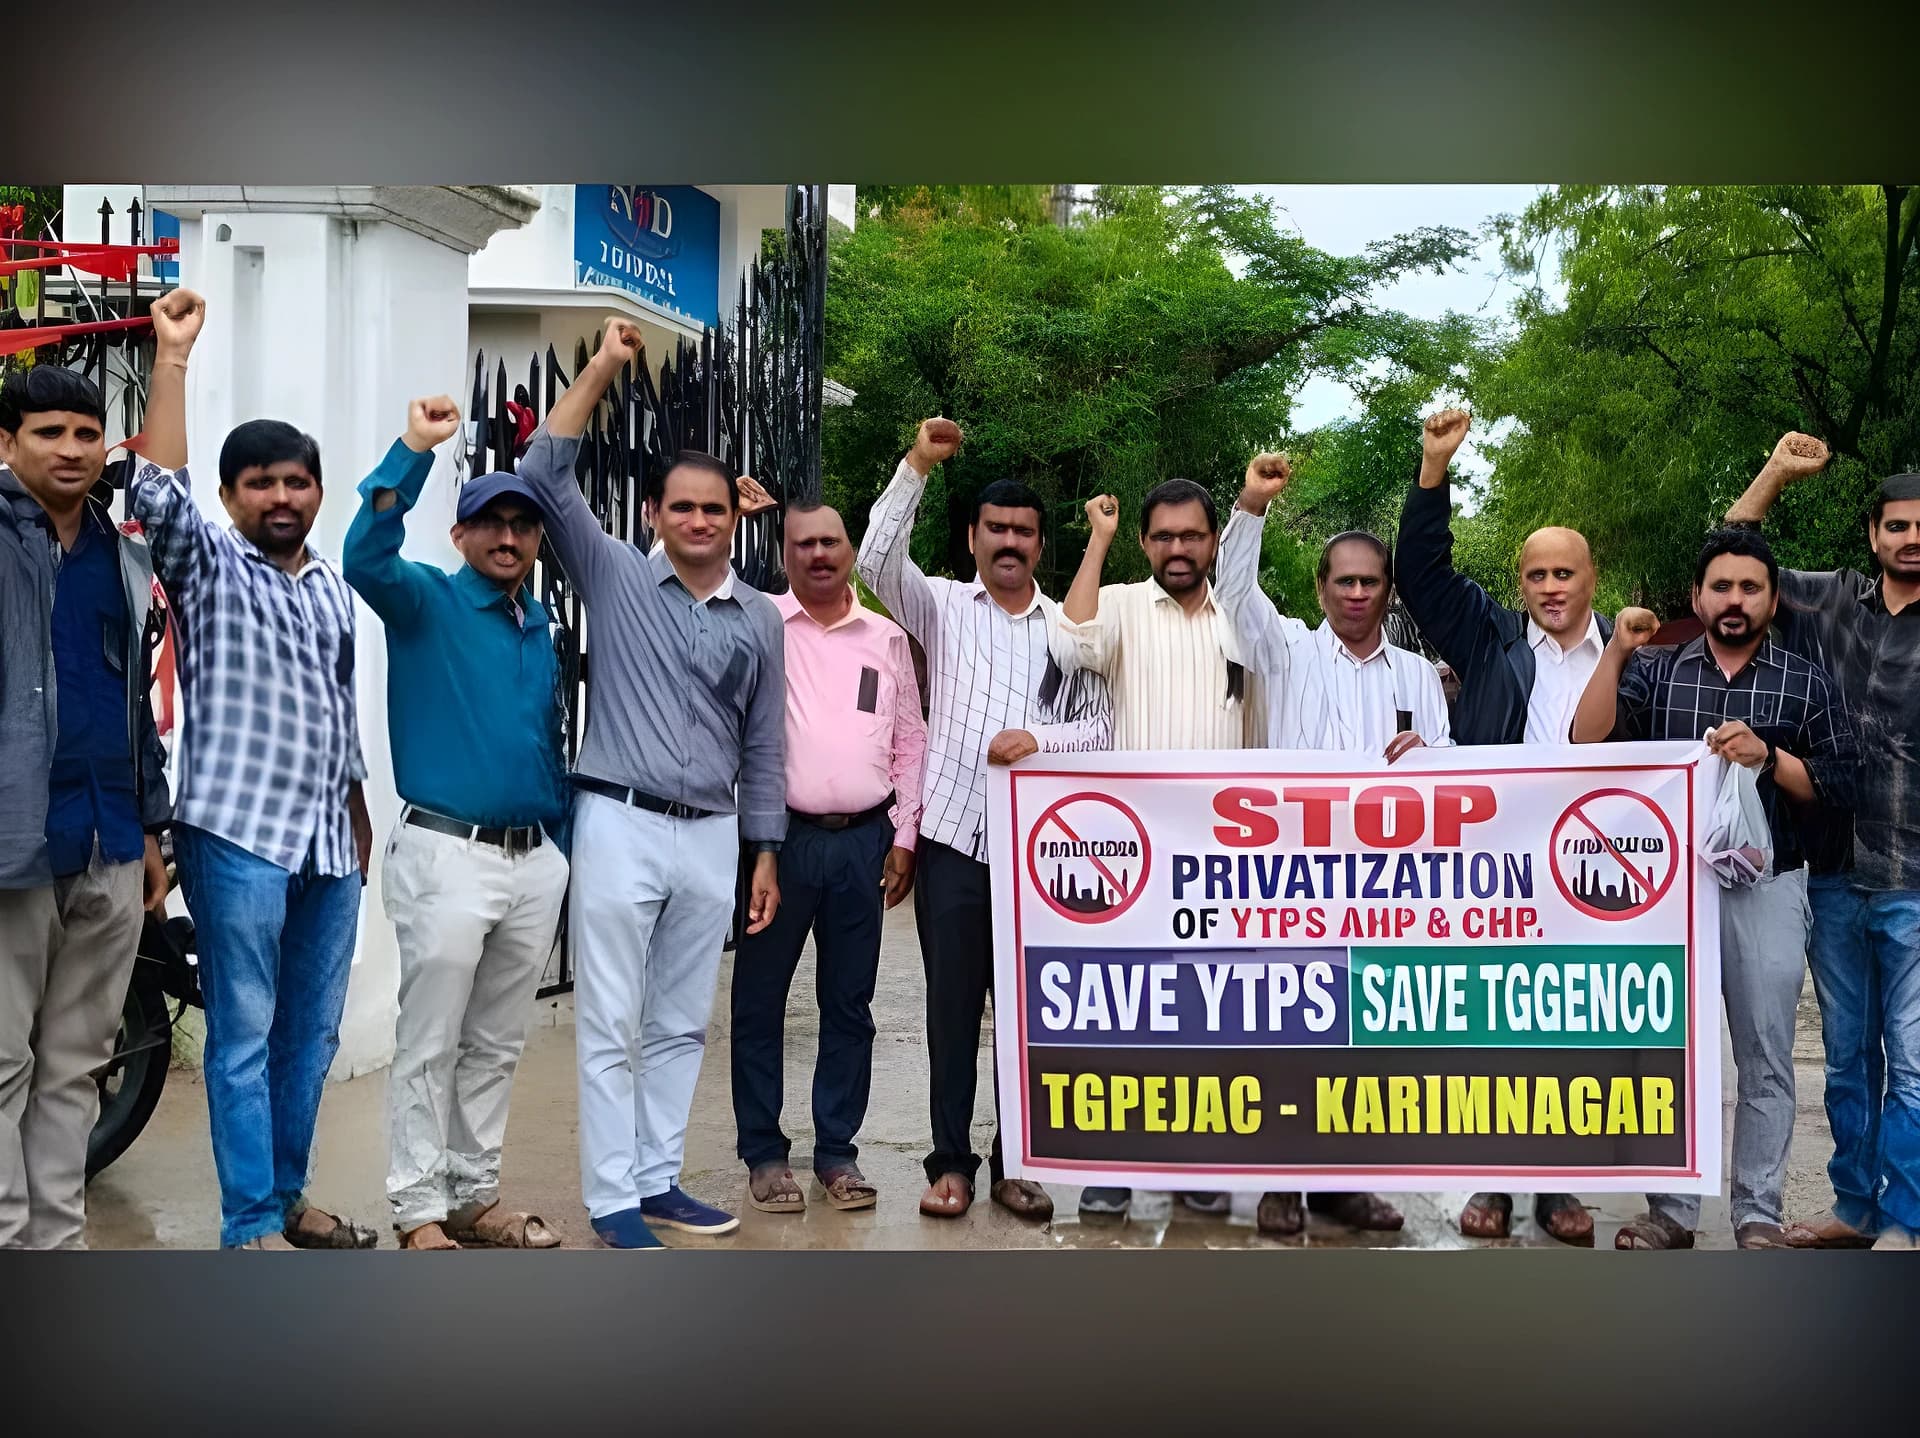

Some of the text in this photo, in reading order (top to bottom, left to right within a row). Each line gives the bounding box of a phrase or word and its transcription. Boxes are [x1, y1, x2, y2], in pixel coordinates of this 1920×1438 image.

[1212, 785, 1497, 848] STOP
[1172, 853, 1534, 900] PRIVATIZATION
[1172, 907, 1219, 939] OF
[1231, 907, 1327, 939] YTPS
[1340, 907, 1416, 938] AHP
[1427, 907, 1451, 939] &
[1040, 961, 1337, 1032] SAVE YTPS
[1362, 962, 1674, 1034] SAVE TGGENCO
[1041, 1073, 1262, 1134] TGPEJAC
[1316, 1075, 1675, 1136] KARIMNAGAR
